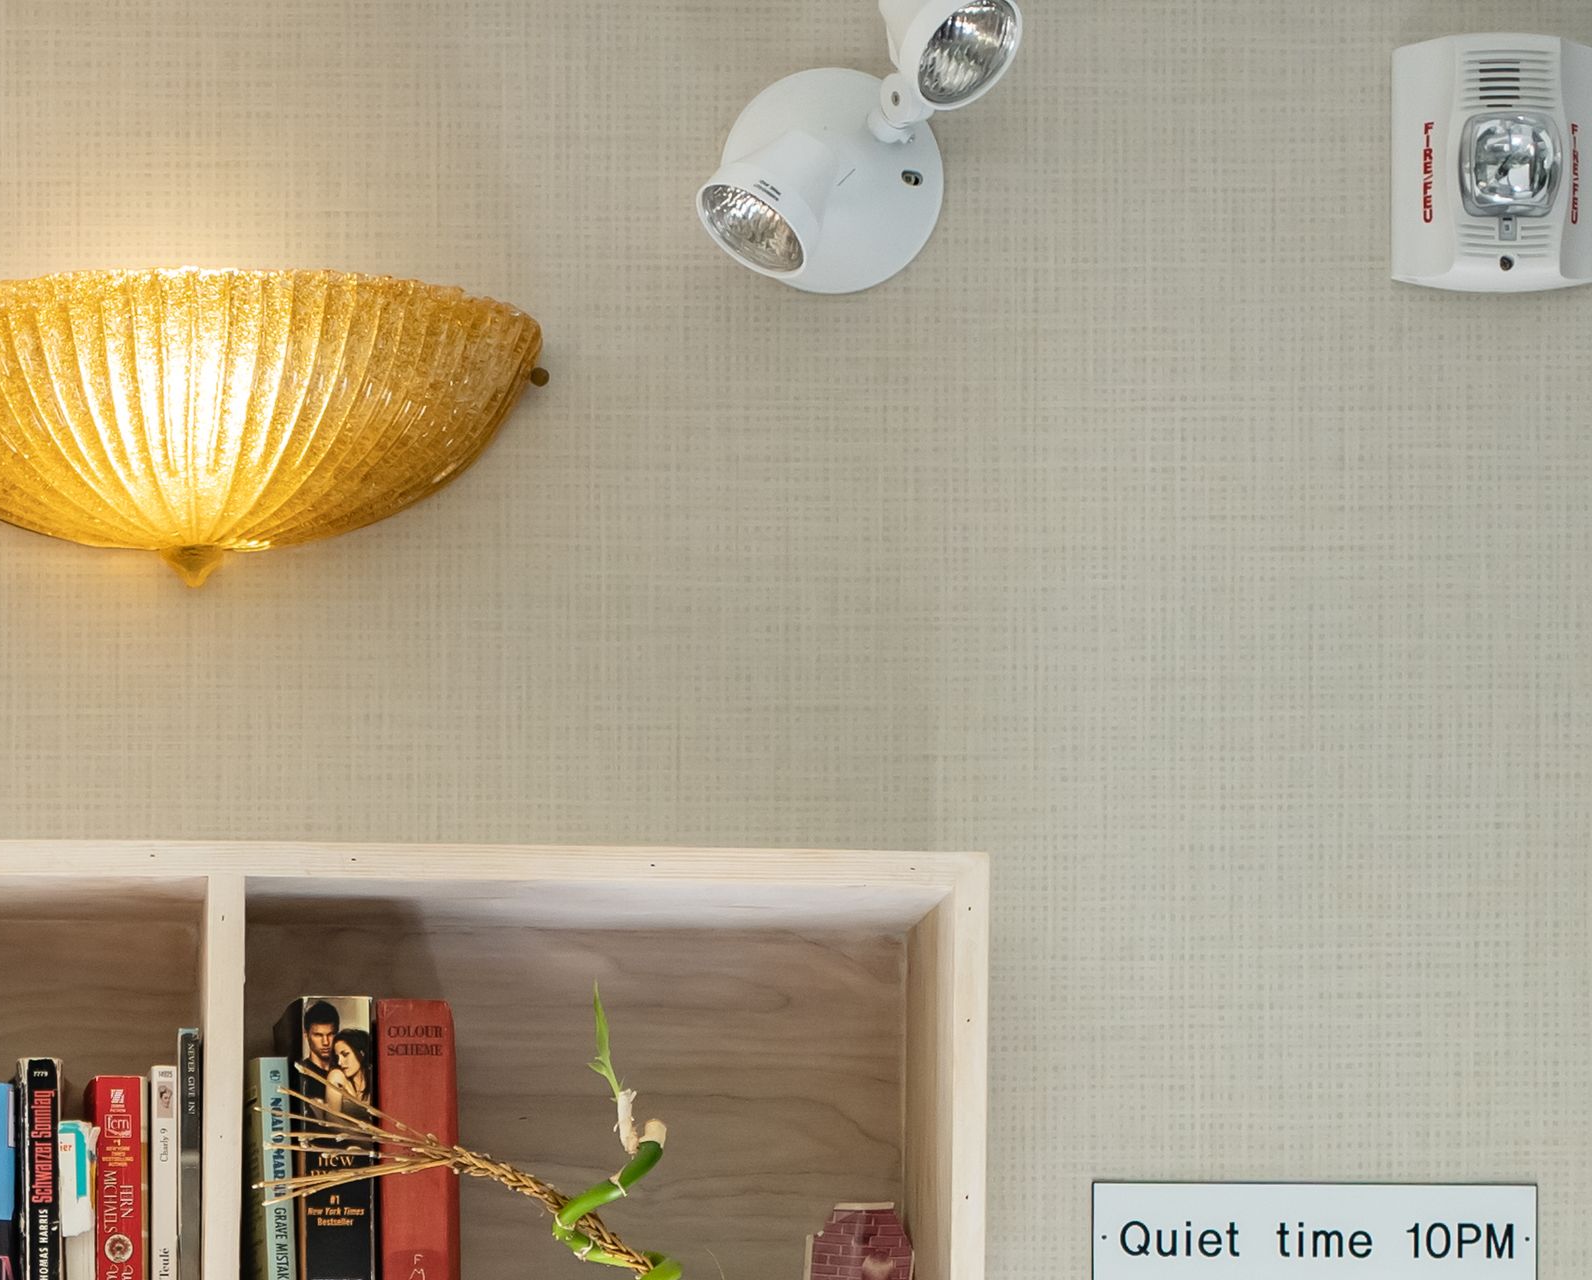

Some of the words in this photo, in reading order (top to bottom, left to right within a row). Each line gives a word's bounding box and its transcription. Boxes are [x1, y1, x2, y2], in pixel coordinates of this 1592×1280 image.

[387, 1025, 443, 1038] COLOUR
[187, 1043, 196, 1073] NEVER
[387, 1043, 443, 1056] SCHEME
[187, 1076, 196, 1098] GIVE
[30, 1089, 56, 1139] Sonntag
[159, 1136, 170, 1163] Charly
[31, 1141, 53, 1204] Schwarzer
[103, 1169, 118, 1234] MICHAELS
[119, 1184, 134, 1219] FERN
[307, 1207, 323, 1216] New
[325, 1207, 342, 1216] York
[344, 1207, 365, 1216] Times
[38, 1208, 49, 1244] HARRIS
[273, 1207, 288, 1239] GRAVE
[317, 1217, 353, 1226] Bestseller
[1119, 1220, 1240, 1257] Quiet
[1276, 1221, 1373, 1258] time
[1406, 1222, 1515, 1259] 10PM
[158, 1247, 170, 1280] Teulé
[409, 1268, 426, 1280] M
[413, 1253, 424, 1265] F
